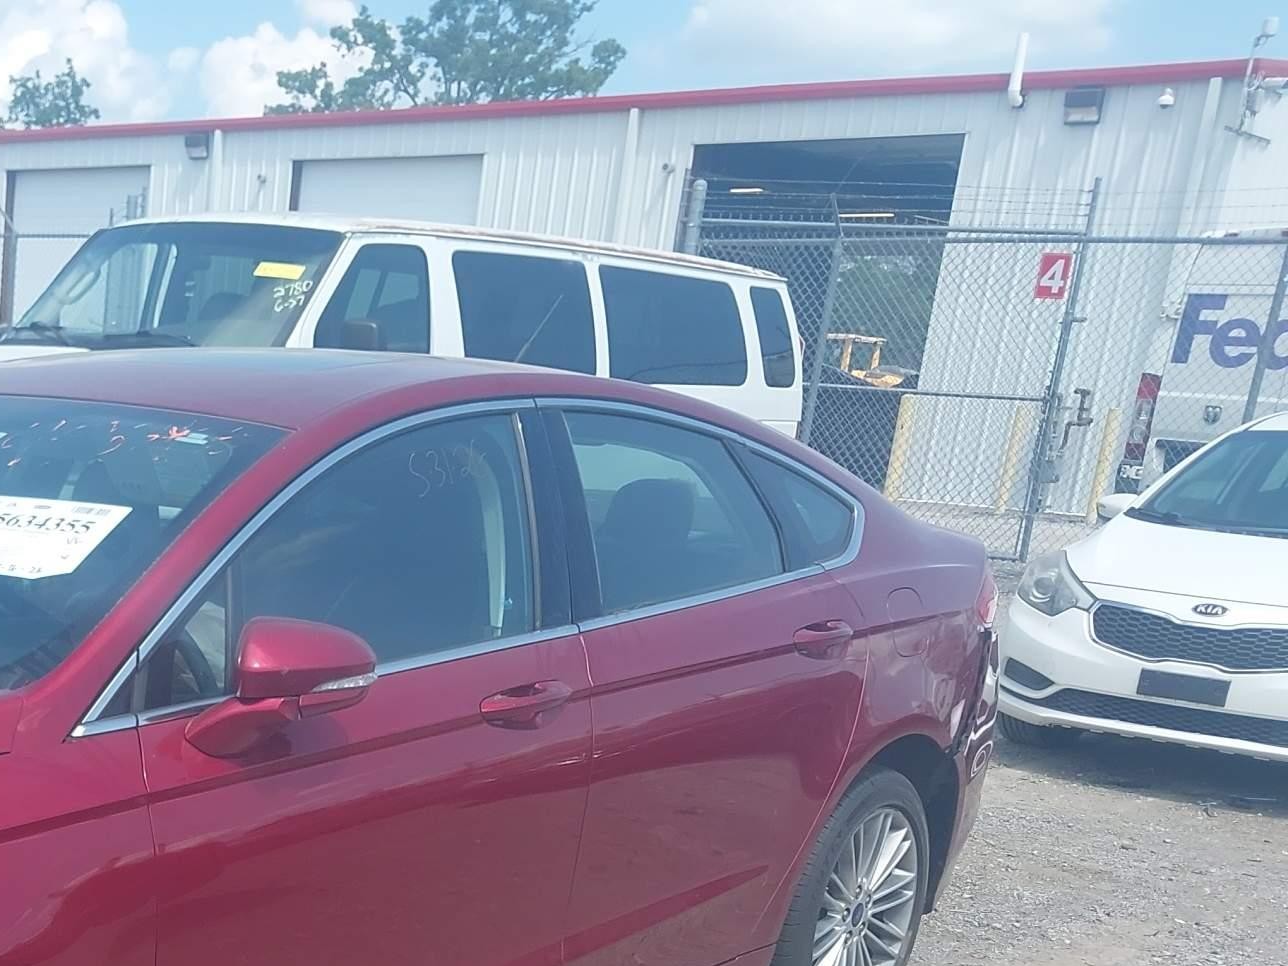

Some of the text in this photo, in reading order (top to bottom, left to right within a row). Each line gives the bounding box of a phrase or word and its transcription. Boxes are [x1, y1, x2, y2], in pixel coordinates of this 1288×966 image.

[1039, 258, 1065, 293] 4
[273, 280, 313, 298] 2780
[1196, 604, 1223, 615] KIA
